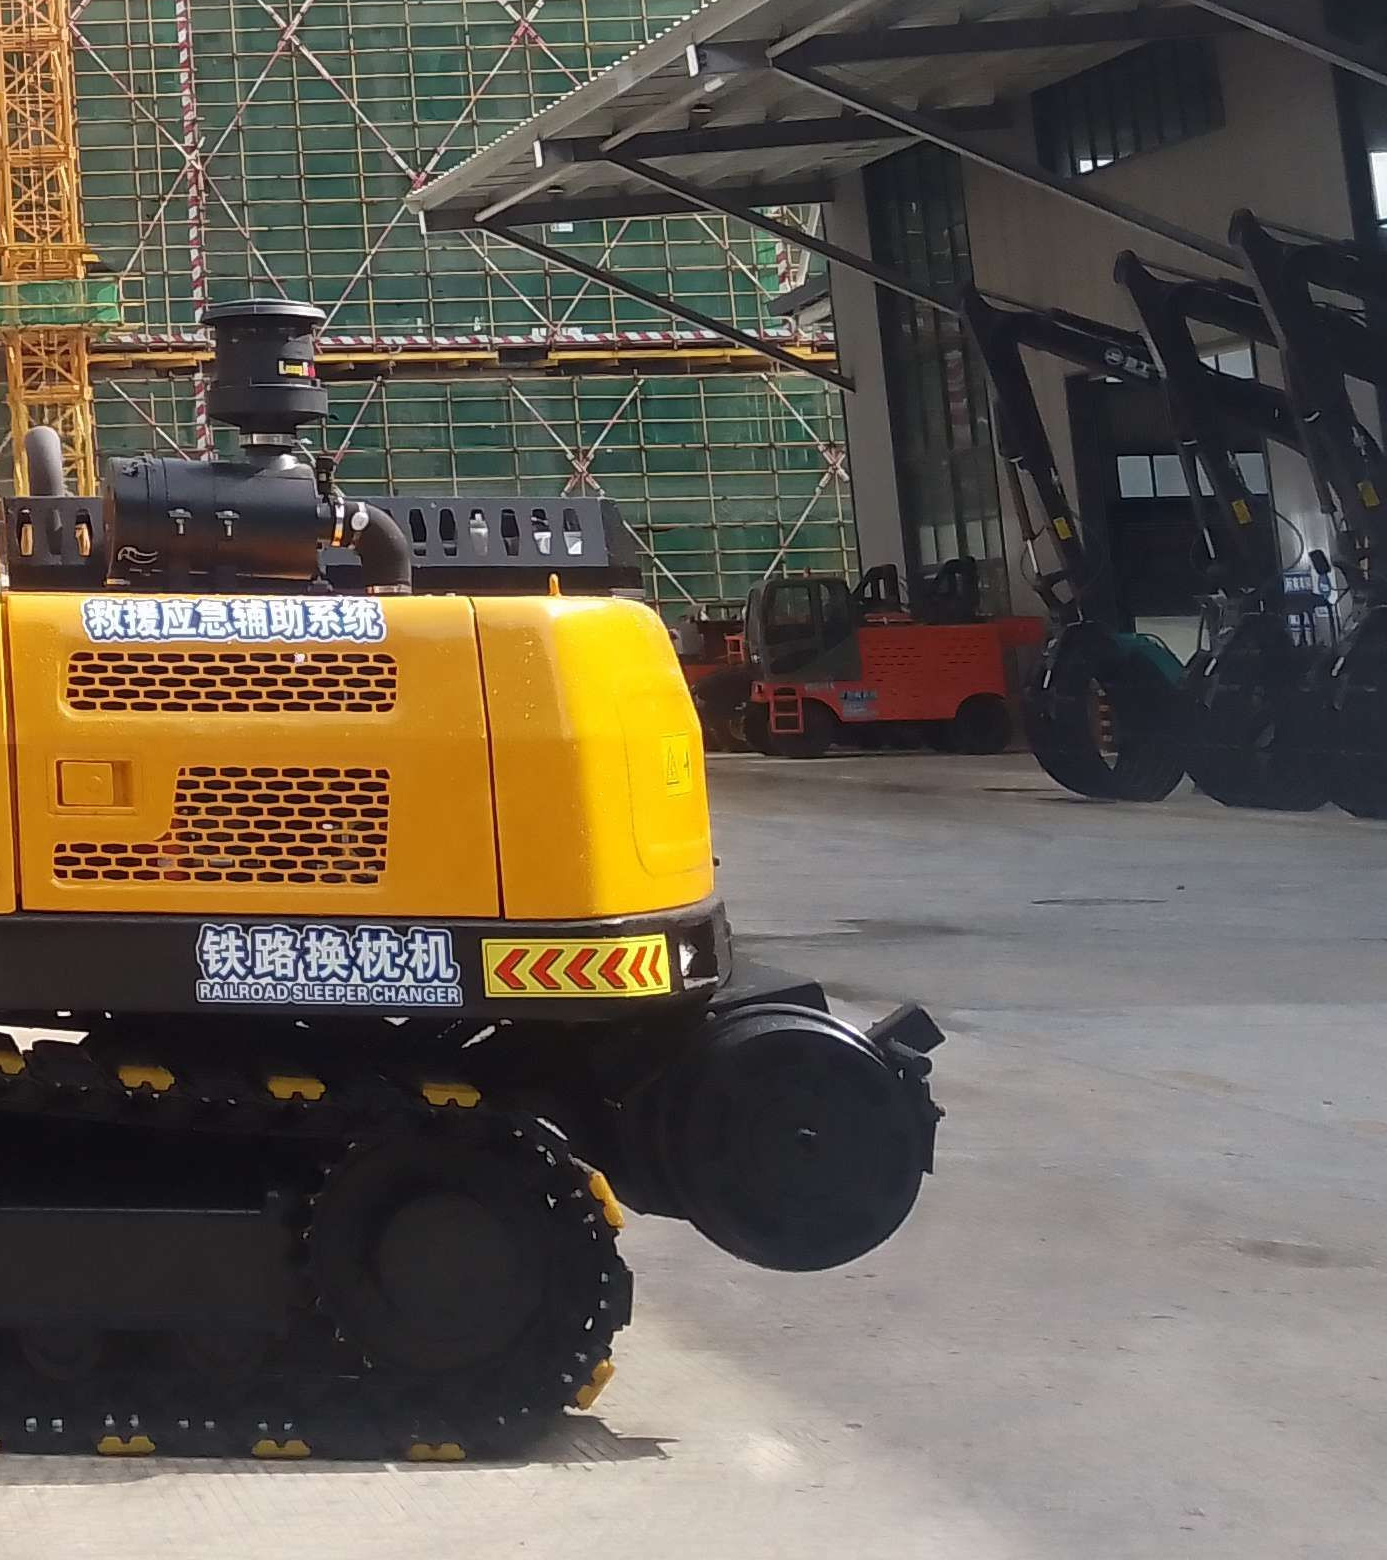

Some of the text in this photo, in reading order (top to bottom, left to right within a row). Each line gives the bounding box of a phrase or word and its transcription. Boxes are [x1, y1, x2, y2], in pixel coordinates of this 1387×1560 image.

[87, 599, 380, 638] 救援应急辅助系统
[202, 930, 454, 979] 铁路换枕机
[200, 983, 460, 1003] RAILROAD SLEEPER CHANGER
